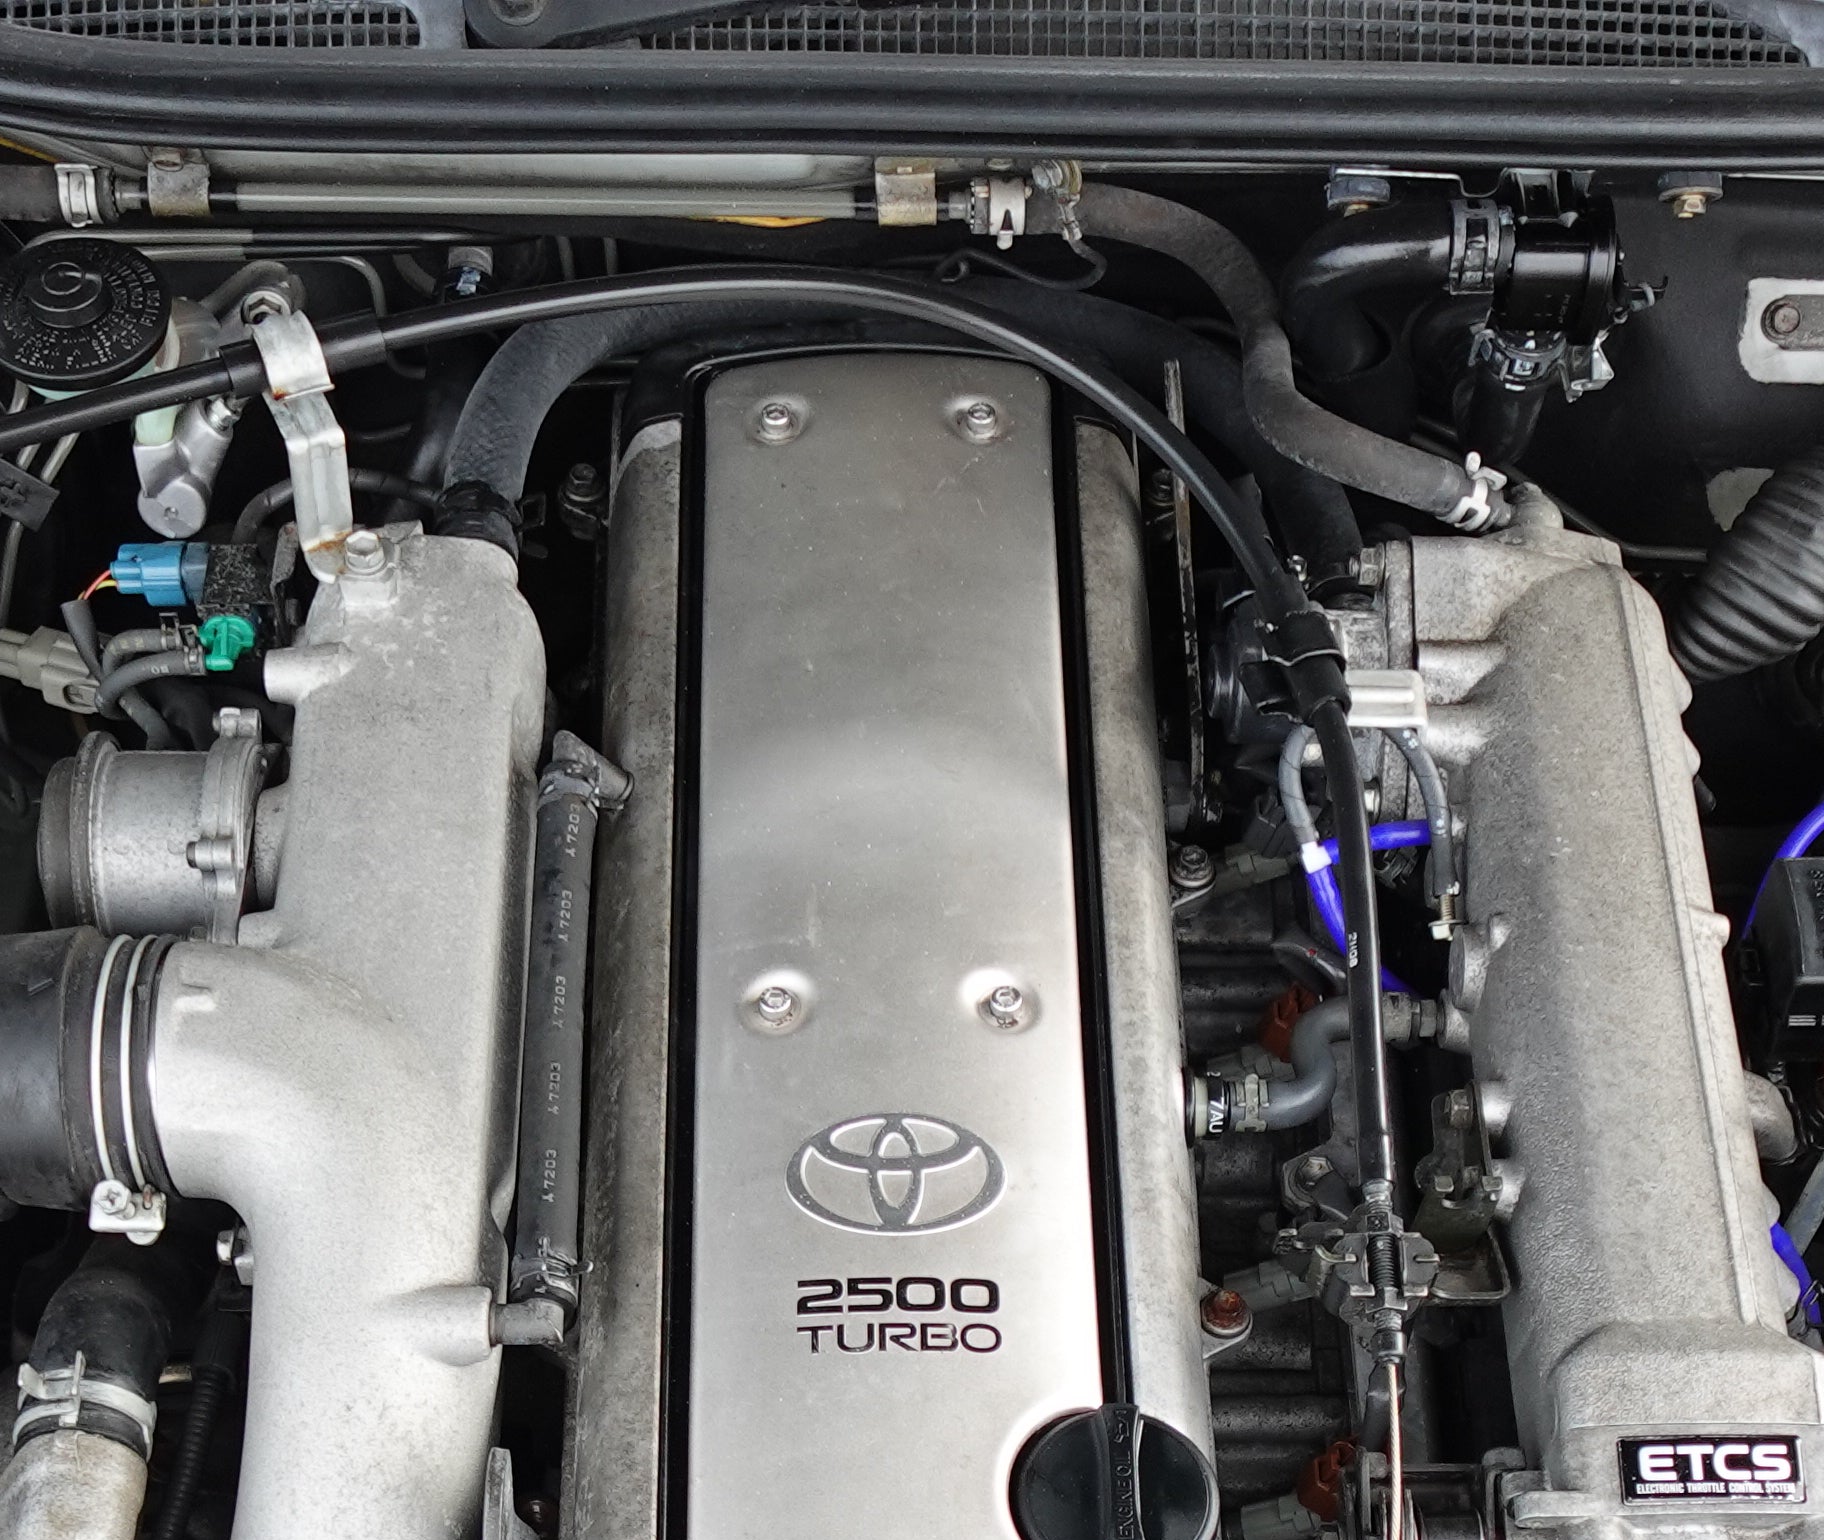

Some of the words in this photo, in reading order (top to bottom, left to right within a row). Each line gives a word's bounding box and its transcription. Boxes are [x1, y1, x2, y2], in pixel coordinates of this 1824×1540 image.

[796, 1276, 1001, 1316] 2500
[796, 1322, 1003, 1354] TURBO
[1637, 1443, 1793, 1483] ETCS
[1636, 1482, 1685, 1495] ELECTRONIC
[1686, 1481, 1726, 1494] THROTTLE
[1116, 1478, 1135, 1540] ENGINE
